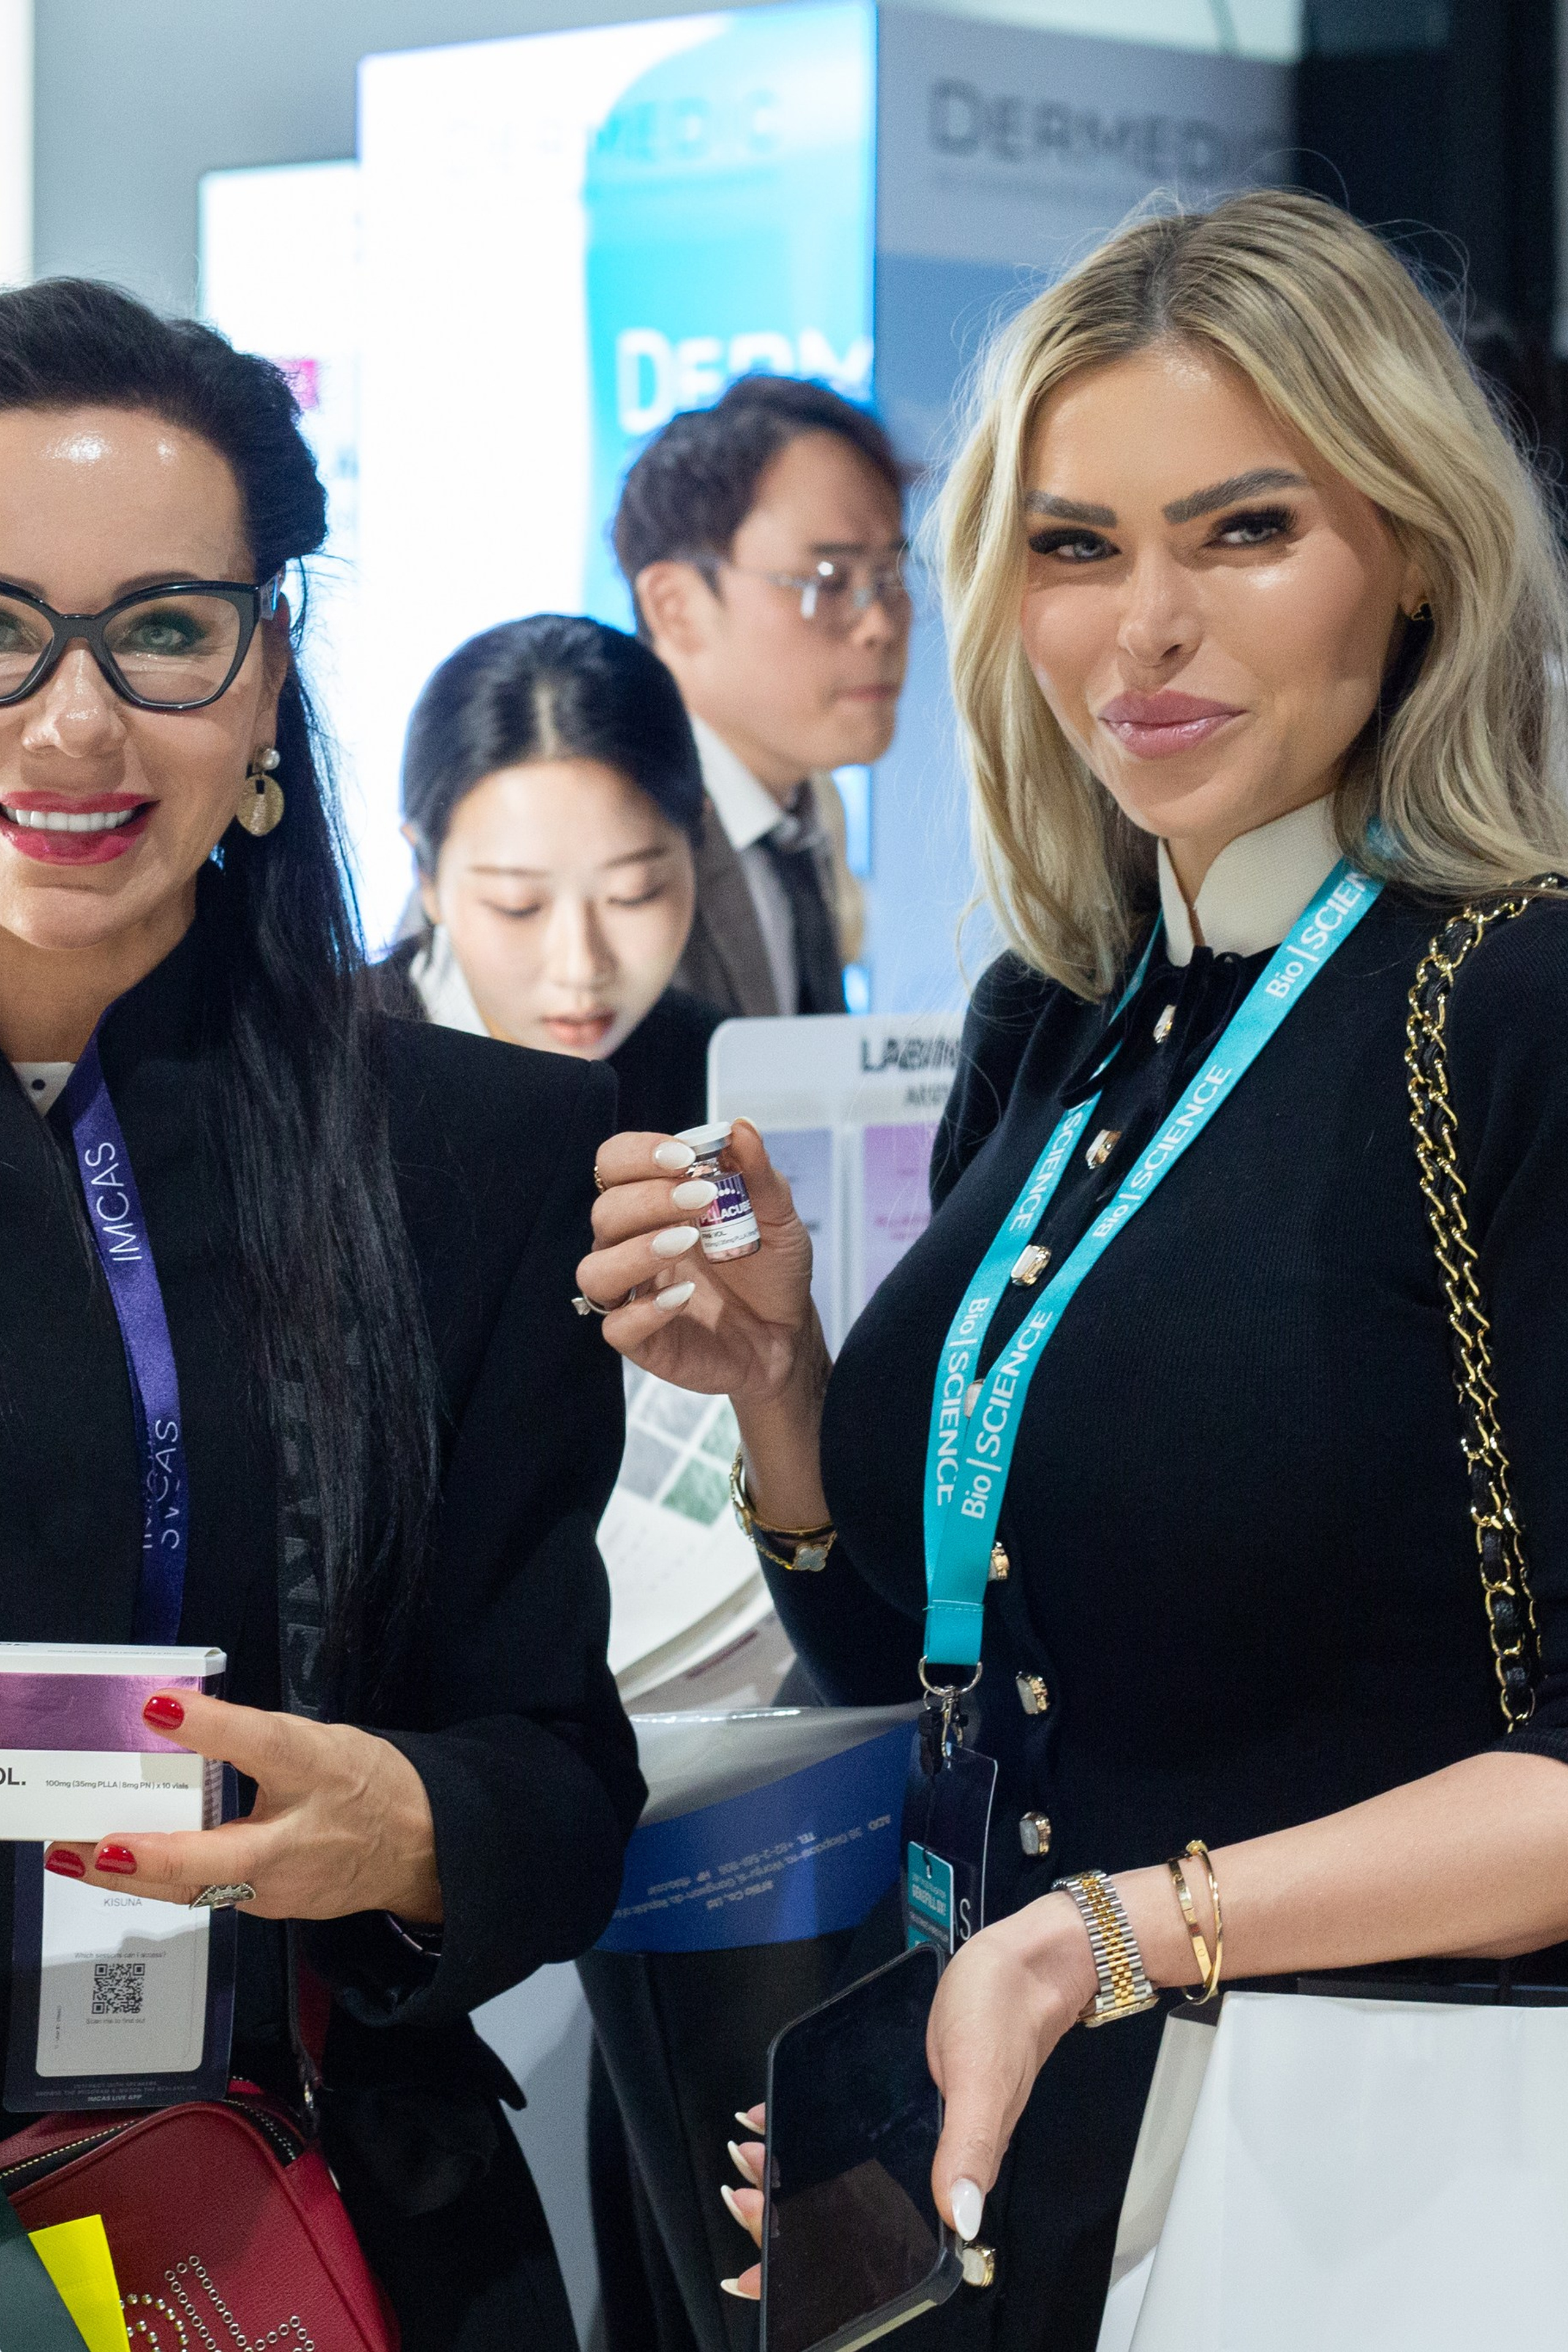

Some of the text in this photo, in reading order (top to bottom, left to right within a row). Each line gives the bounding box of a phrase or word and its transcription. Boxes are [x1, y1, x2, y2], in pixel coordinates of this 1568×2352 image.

[1265, 961, 1303, 998] Bio
[1009, 1112, 1083, 1232] SCIENCE
[1093, 1204, 1129, 1237] Bio
[1130, 1064, 1233, 1190] SCIENCE
[85, 1143, 142, 1261] IMCAS
[959, 1297, 990, 1335] Bio
[976, 1310, 1054, 1458] SCIENCE
[937, 1351, 970, 1506] SCIENCE
[961, 1474, 992, 1520] Bio
[72, 1780, 97, 1789] (35mg
[104, 1898, 142, 1907] KISUNA
